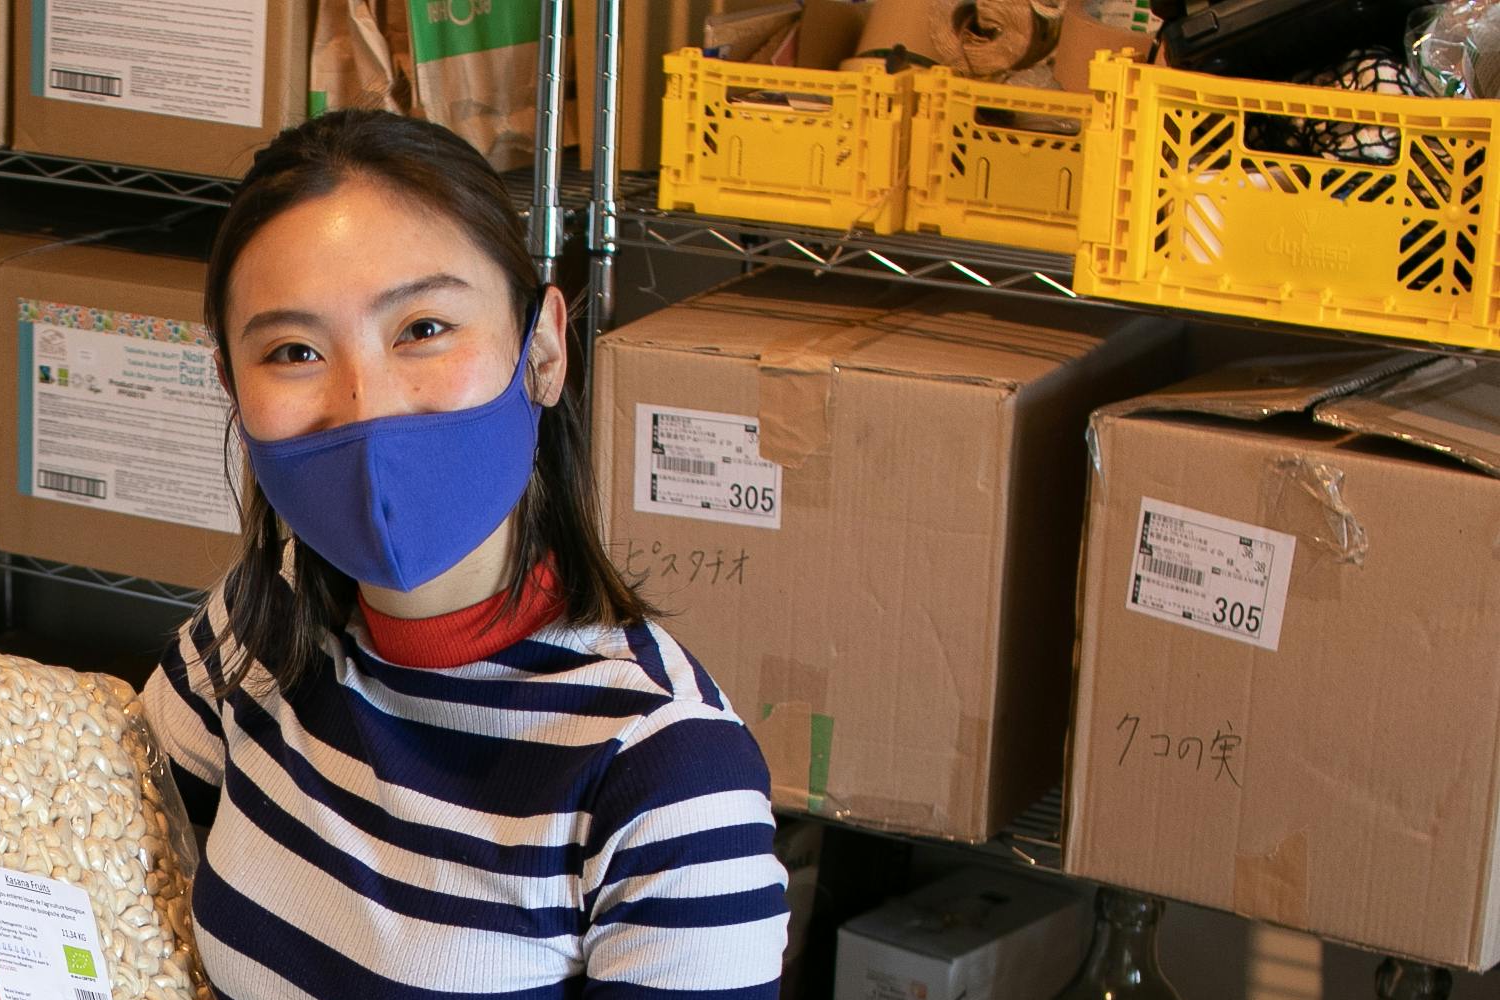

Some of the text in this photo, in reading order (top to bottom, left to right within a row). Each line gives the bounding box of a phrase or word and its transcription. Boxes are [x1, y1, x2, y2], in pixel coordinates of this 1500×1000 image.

[729, 483, 774, 512] 305
[625, 541, 750, 585] ピスタチオ
[1212, 597, 1262, 632] 305
[1116, 713, 1244, 789] クコの実
[5, 874, 51, 893] Kasana Fruits
